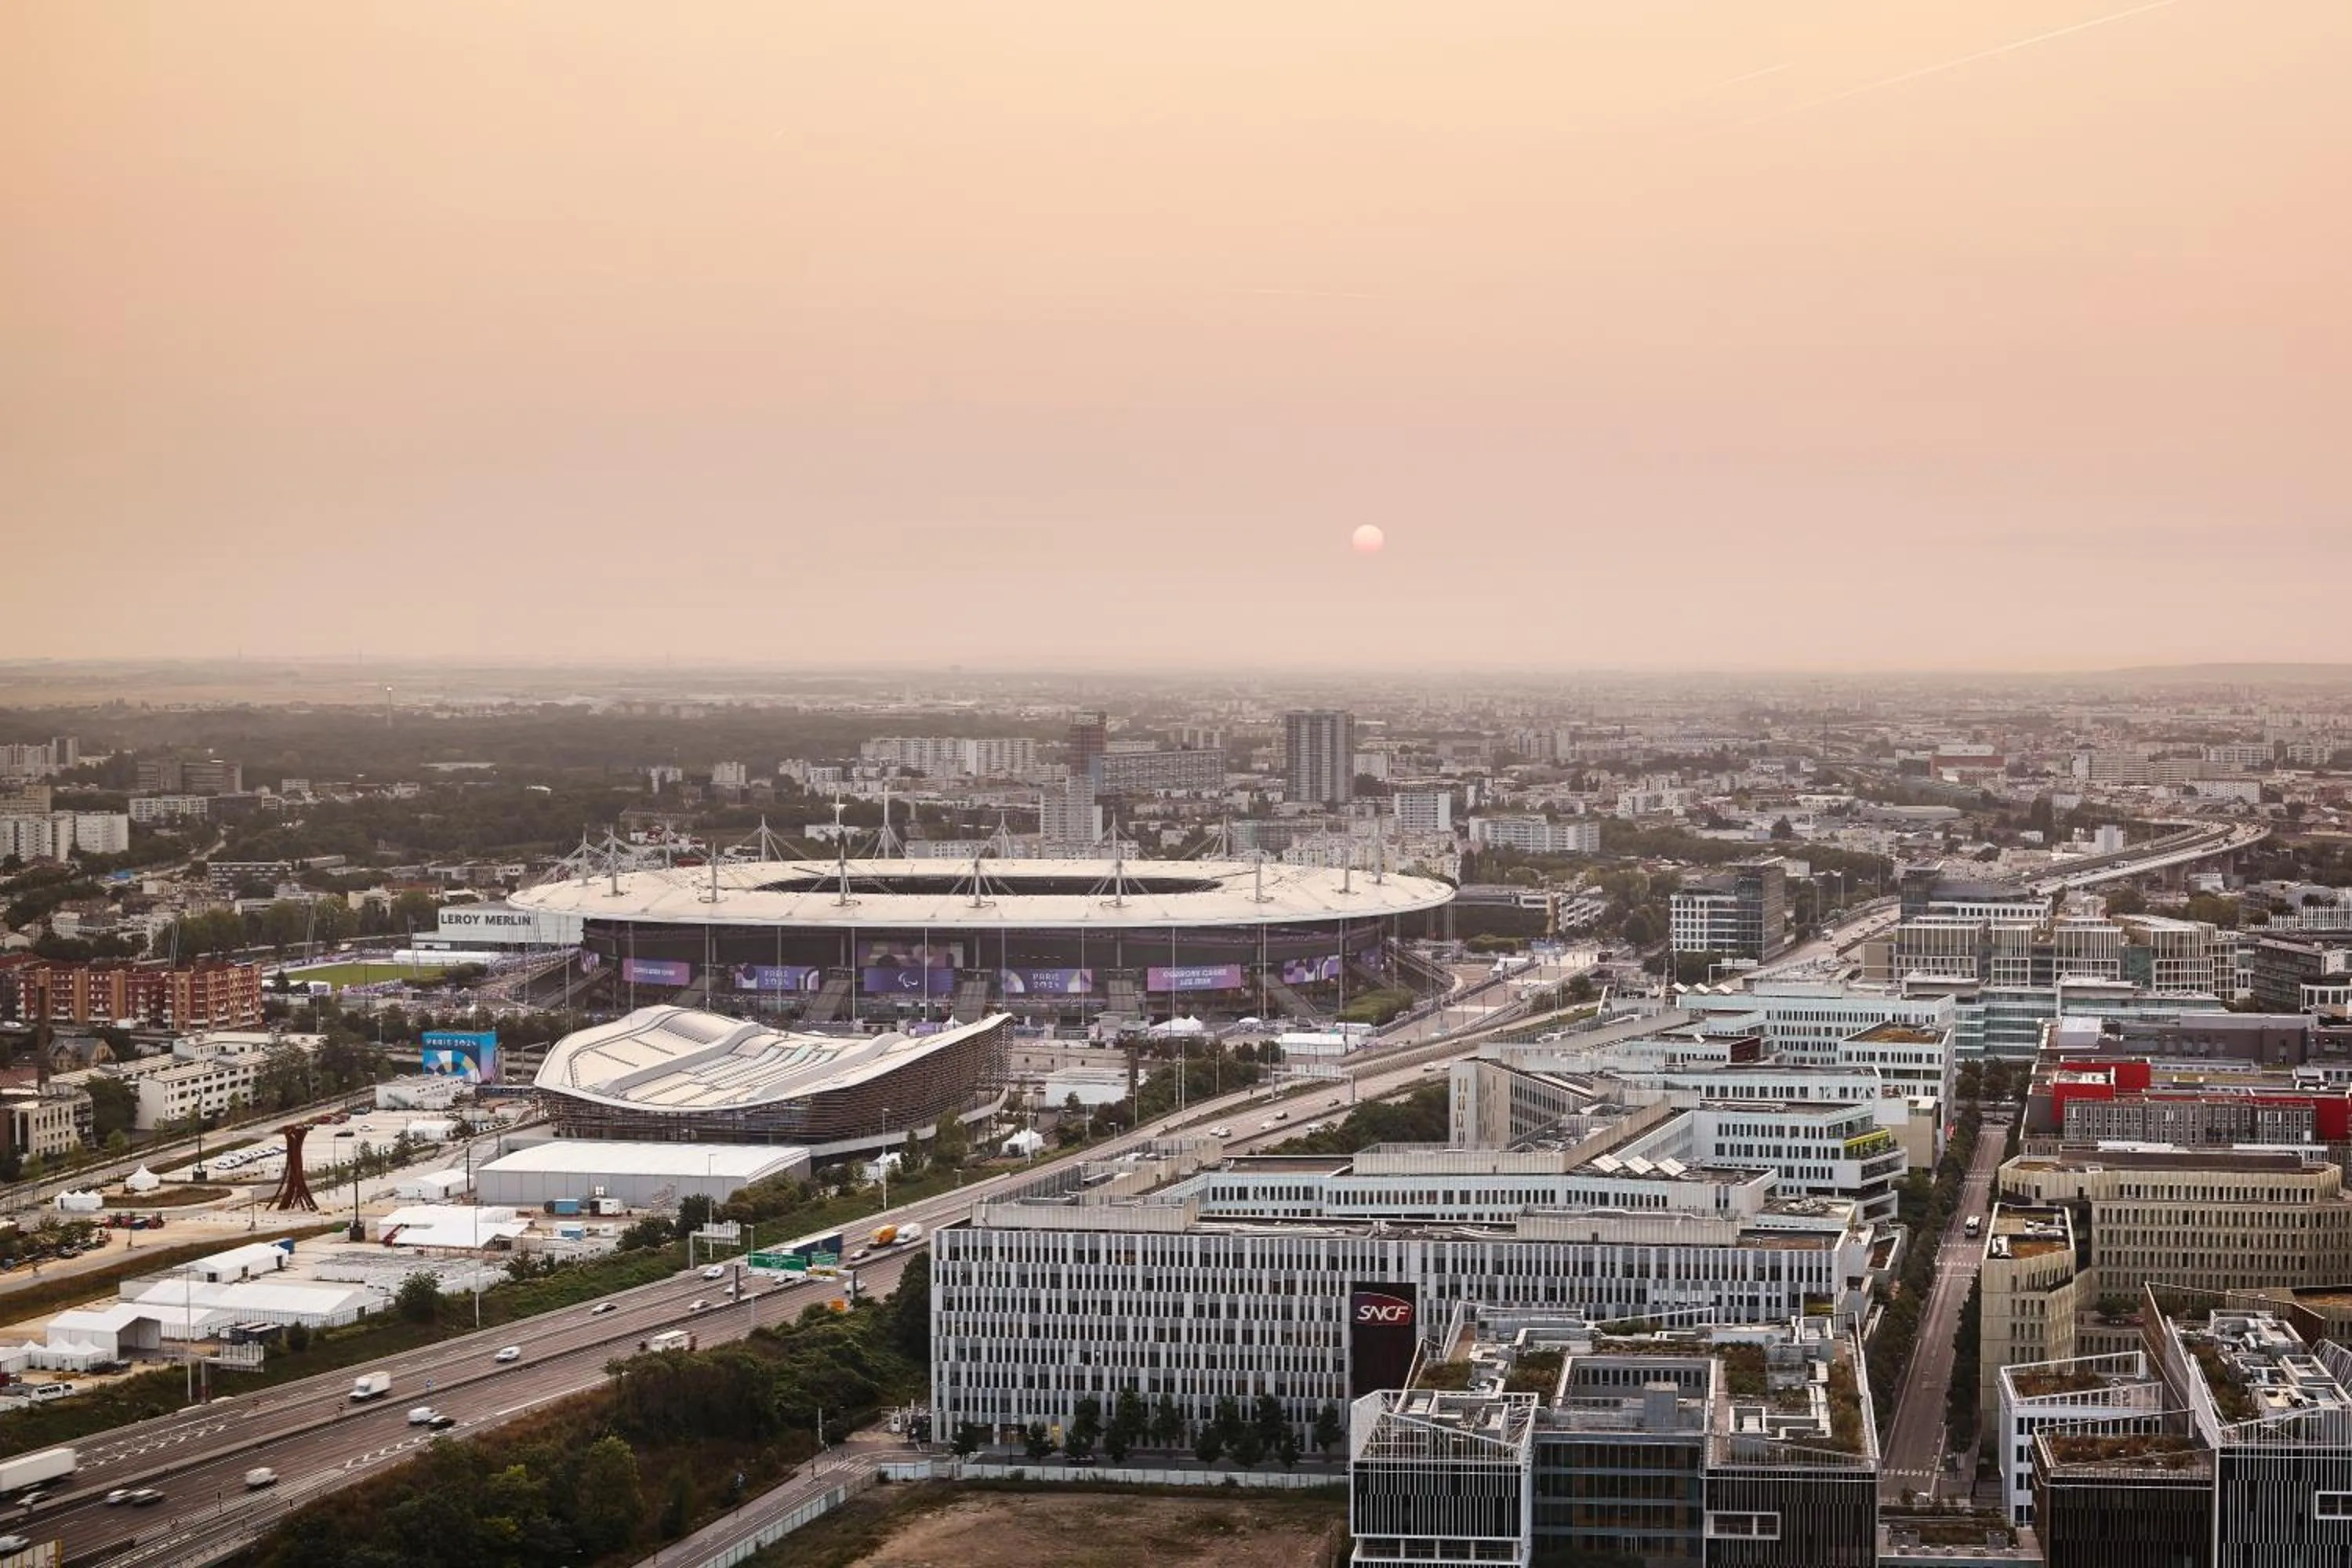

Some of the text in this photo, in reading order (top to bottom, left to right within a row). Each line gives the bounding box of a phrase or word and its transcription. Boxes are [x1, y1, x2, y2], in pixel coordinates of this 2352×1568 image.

[441, 913, 531, 925] LEROY MERLIN
[1357, 1305, 1409, 1320] SNCF
